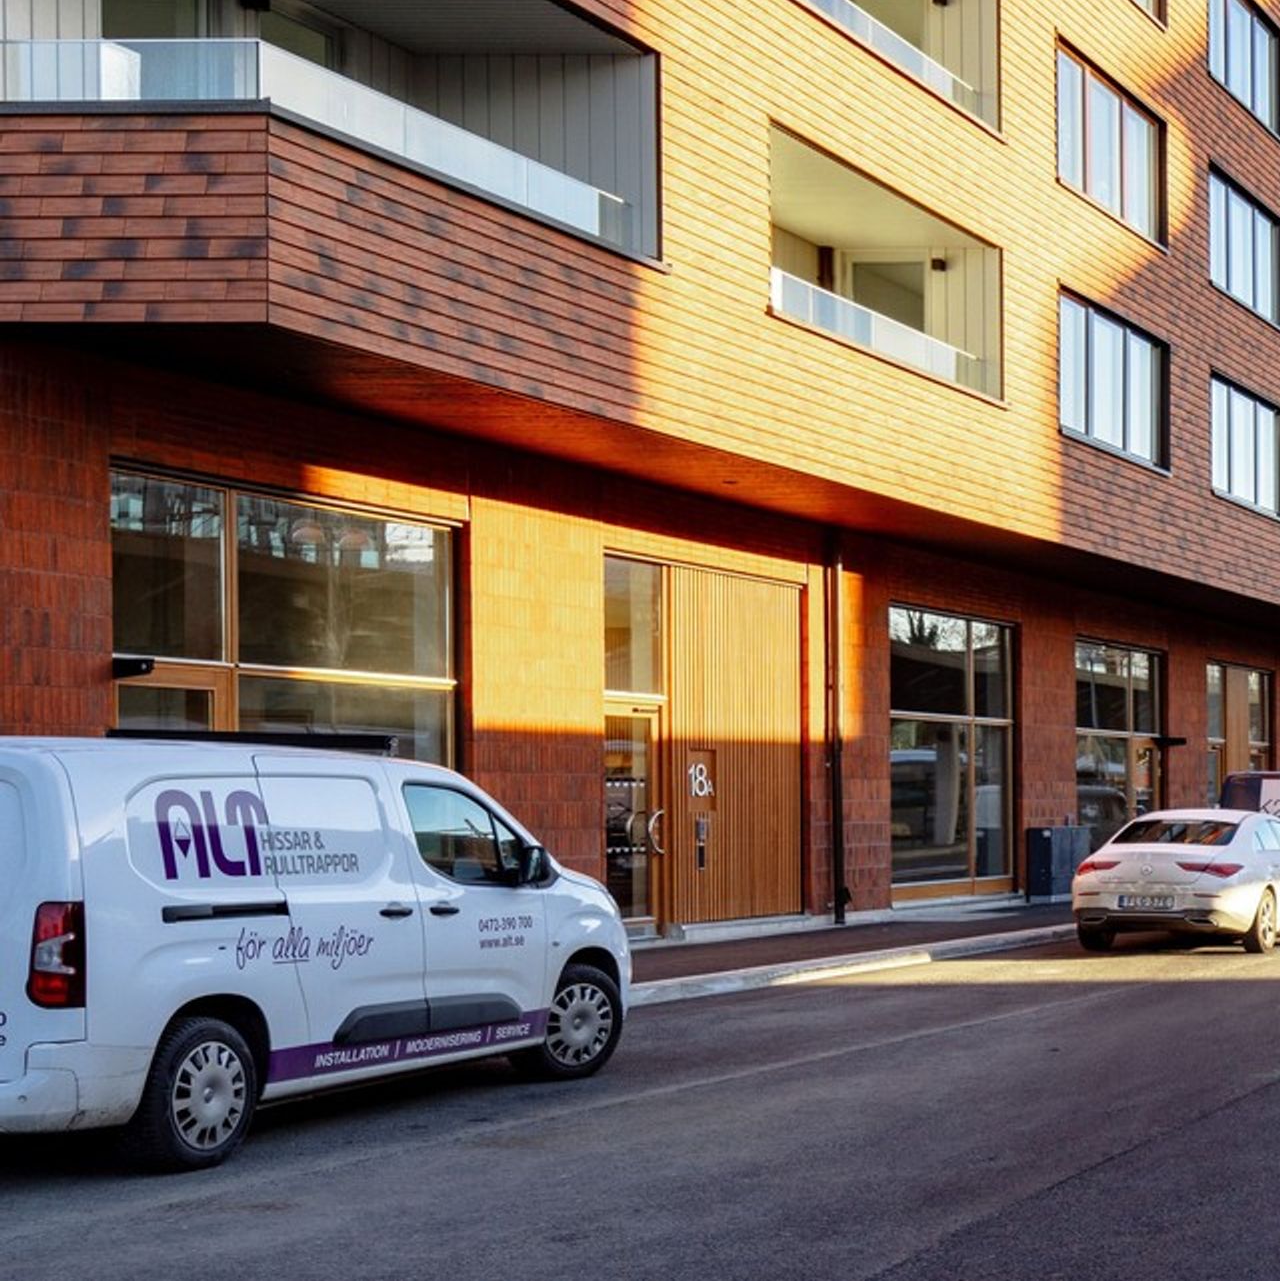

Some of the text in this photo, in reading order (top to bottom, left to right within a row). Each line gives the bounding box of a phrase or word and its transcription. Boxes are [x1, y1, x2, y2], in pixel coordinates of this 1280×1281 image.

[688, 763, 715, 797] 18A
[155, 789, 269, 880] ALT
[260, 831, 326, 850] HISSAR &
[264, 853, 360, 875] RULLTRAPPOR
[236, 927, 266, 970] för
[272, 926, 311, 961] alla
[316, 925, 375, 970] miljöer
[314, 1044, 390, 1068] INSTALLATION
[406, 1031, 482, 1054] MODERNISERING
[495, 1023, 531, 1039] SERVICE
